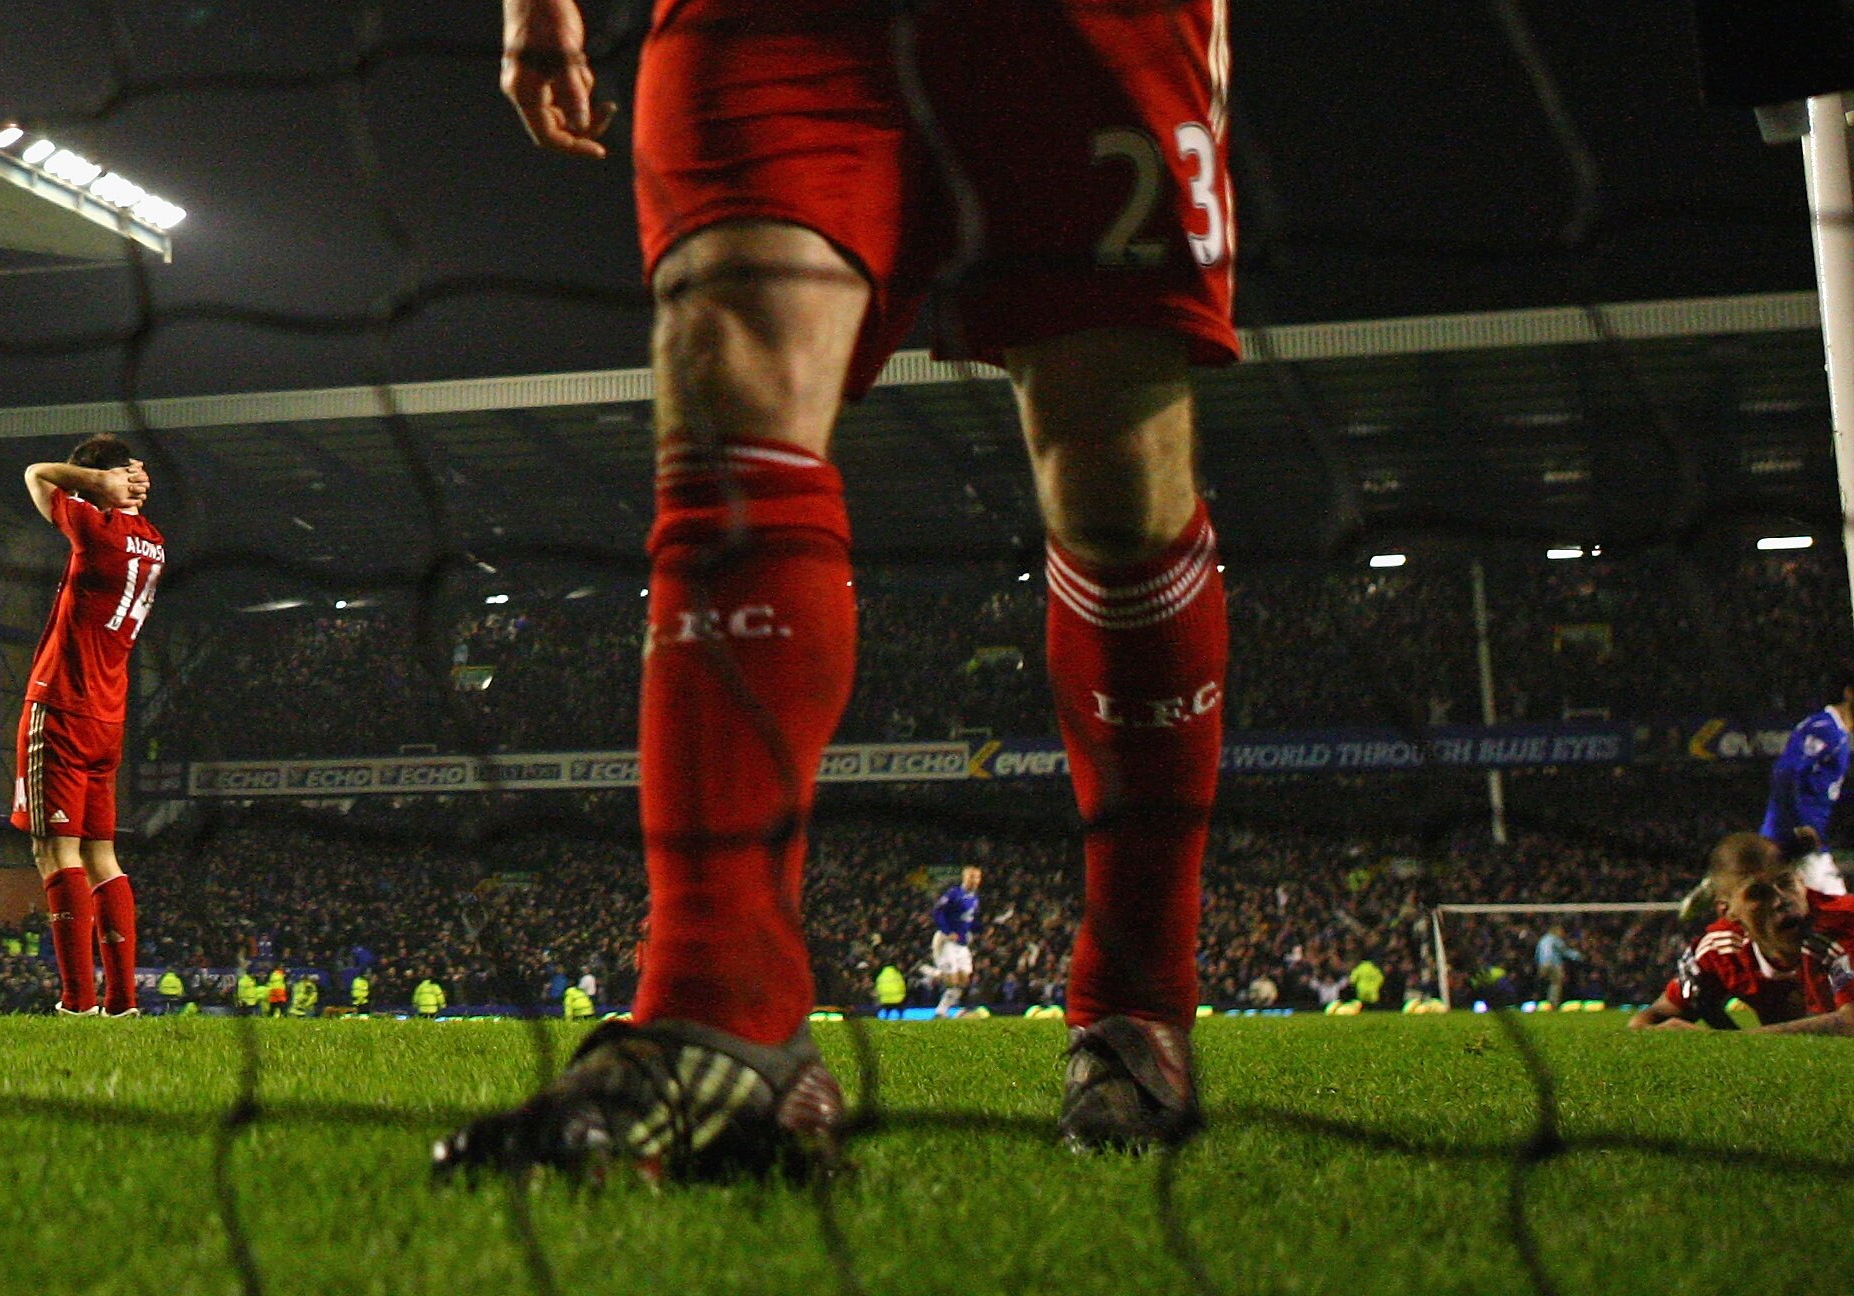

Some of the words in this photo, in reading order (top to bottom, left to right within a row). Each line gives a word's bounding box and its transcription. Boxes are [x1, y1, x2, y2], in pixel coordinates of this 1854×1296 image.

[1091, 121, 1225, 267] 23
[104, 557, 164, 641] 14
[823, 754, 859, 775] HO
[891, 751, 963, 773] ECHO
[1233, 742, 1331, 770] WORLD
[305, 766, 373, 787] ECHO
[399, 762, 467, 785] ECHO
[589, 760, 639, 781] ECH
